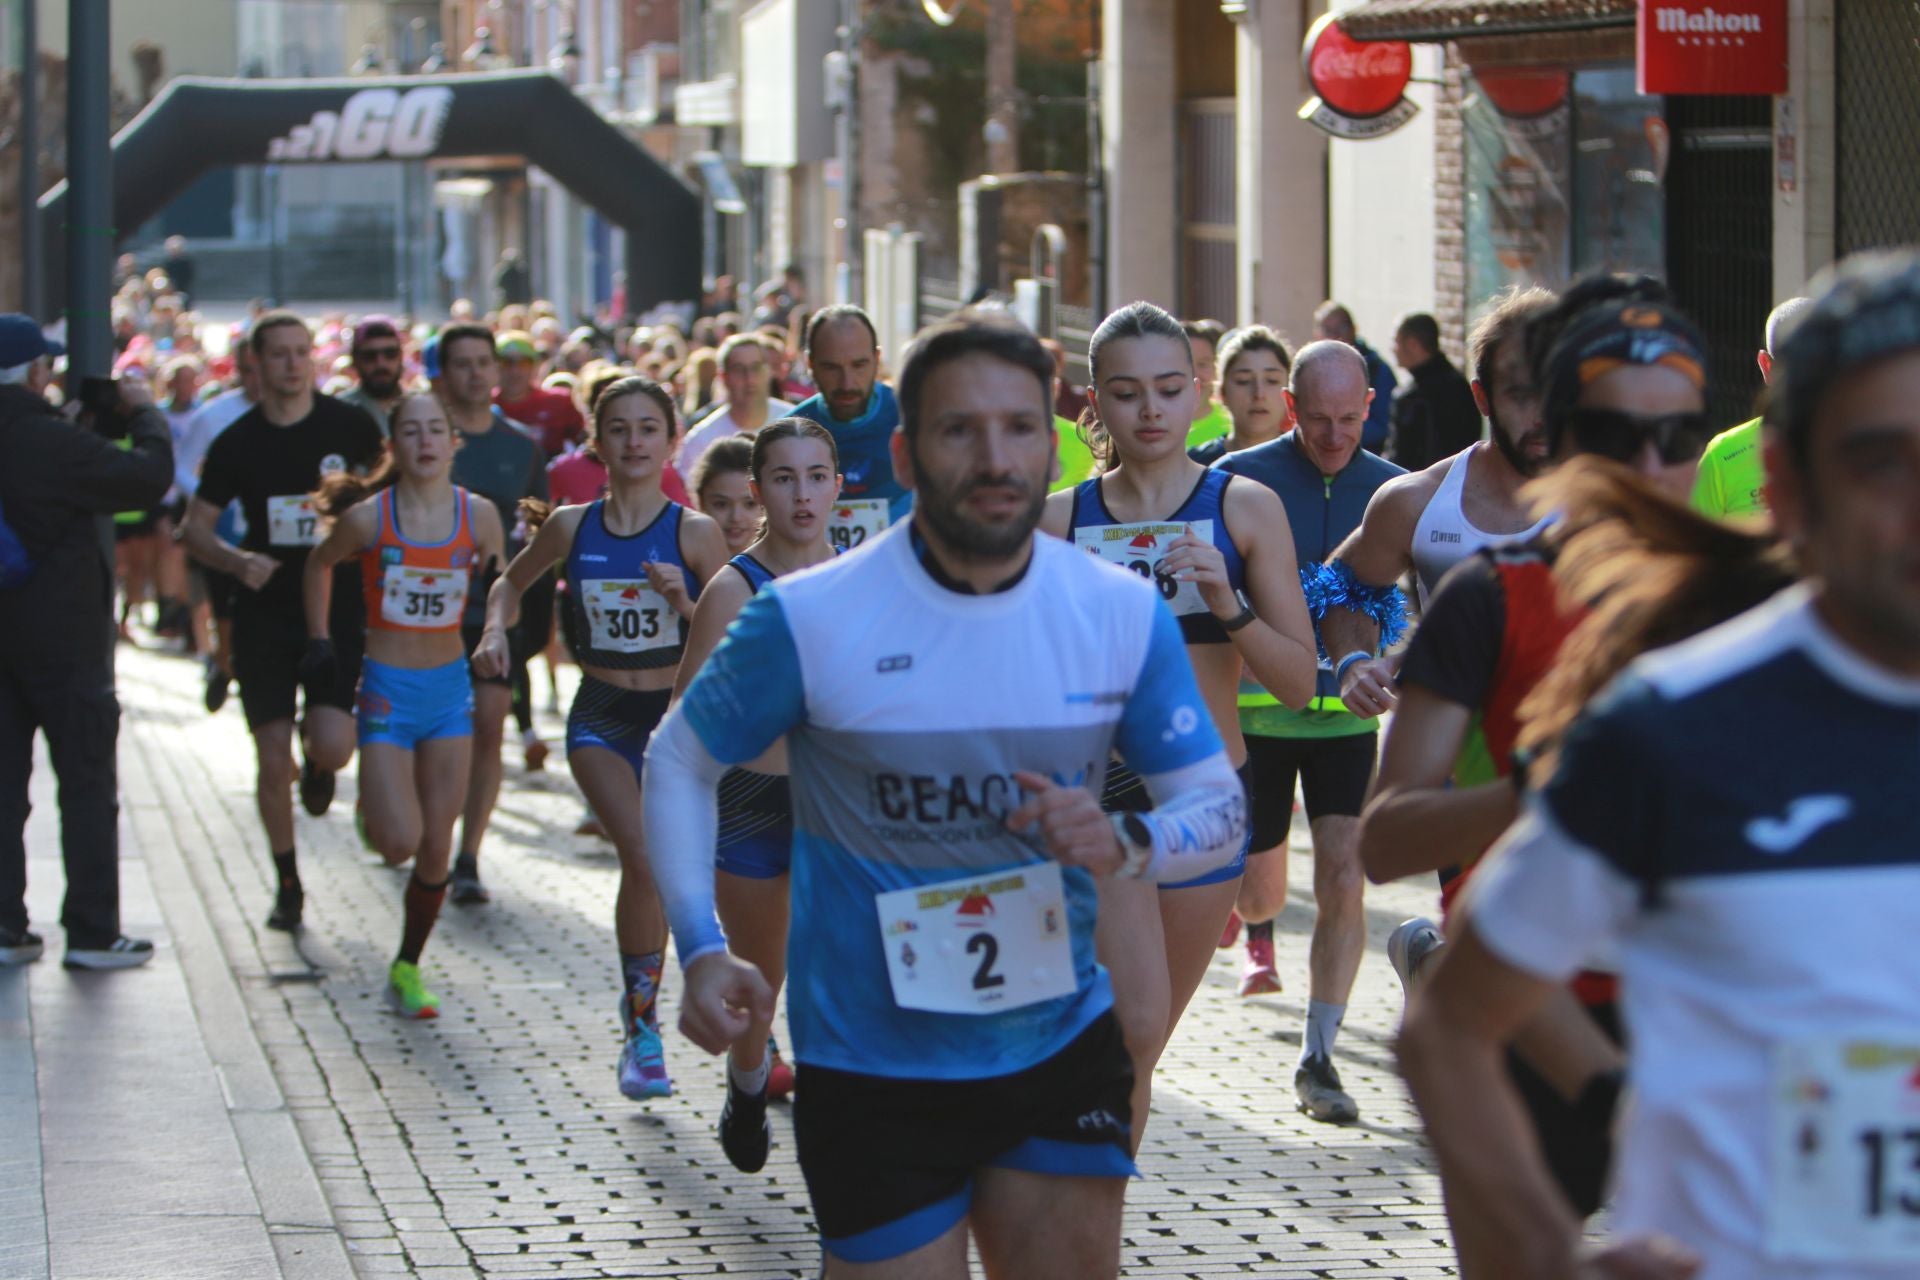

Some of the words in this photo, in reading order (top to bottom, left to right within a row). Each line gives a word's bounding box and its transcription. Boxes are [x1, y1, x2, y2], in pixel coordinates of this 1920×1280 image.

[1656, 7, 1762, 32] Mahou
[829, 526, 866, 549] 192
[404, 591, 445, 616] 315
[604, 608, 659, 640] 303
[966, 931, 1005, 990] 2
